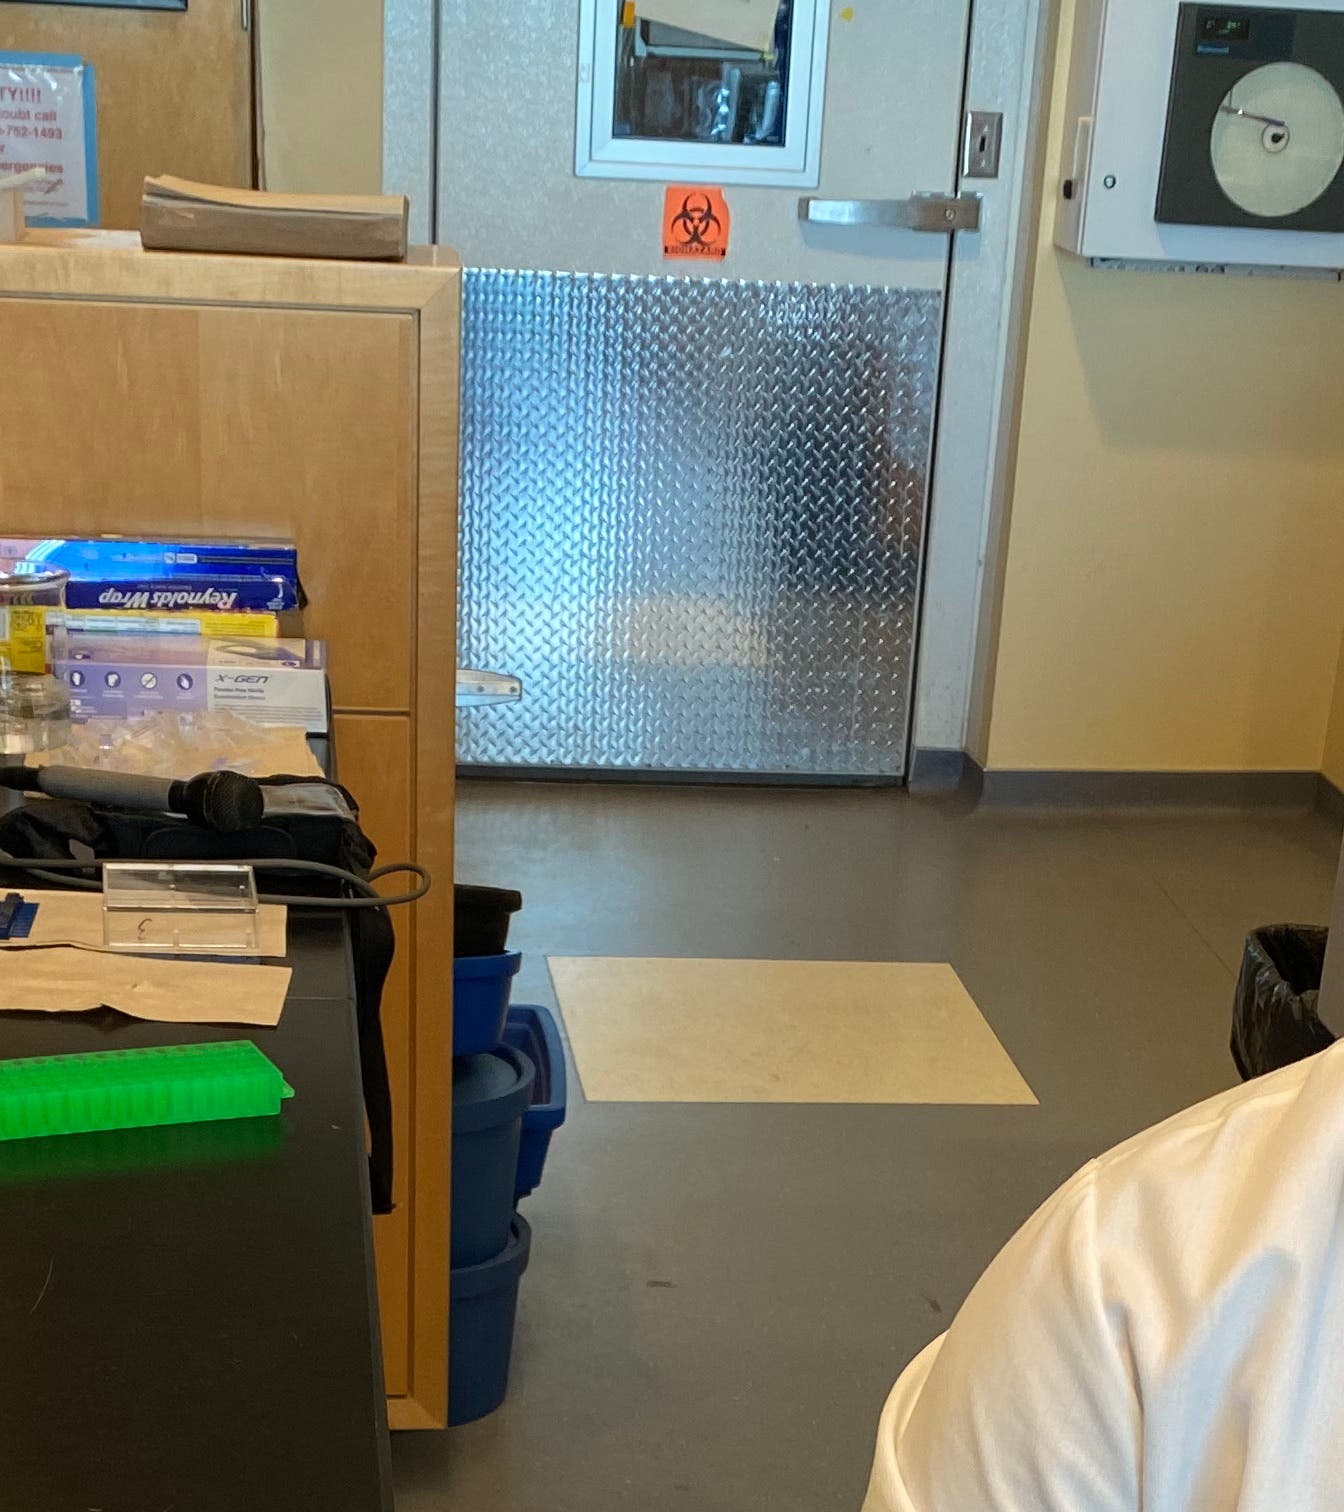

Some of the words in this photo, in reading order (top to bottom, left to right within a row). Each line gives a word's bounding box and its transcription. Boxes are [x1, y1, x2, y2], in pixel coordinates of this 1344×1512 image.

[35, 110, 57, 121] call
[99, 588, 149, 609] Wrap
[150, 588, 237, 610] Reynolds
